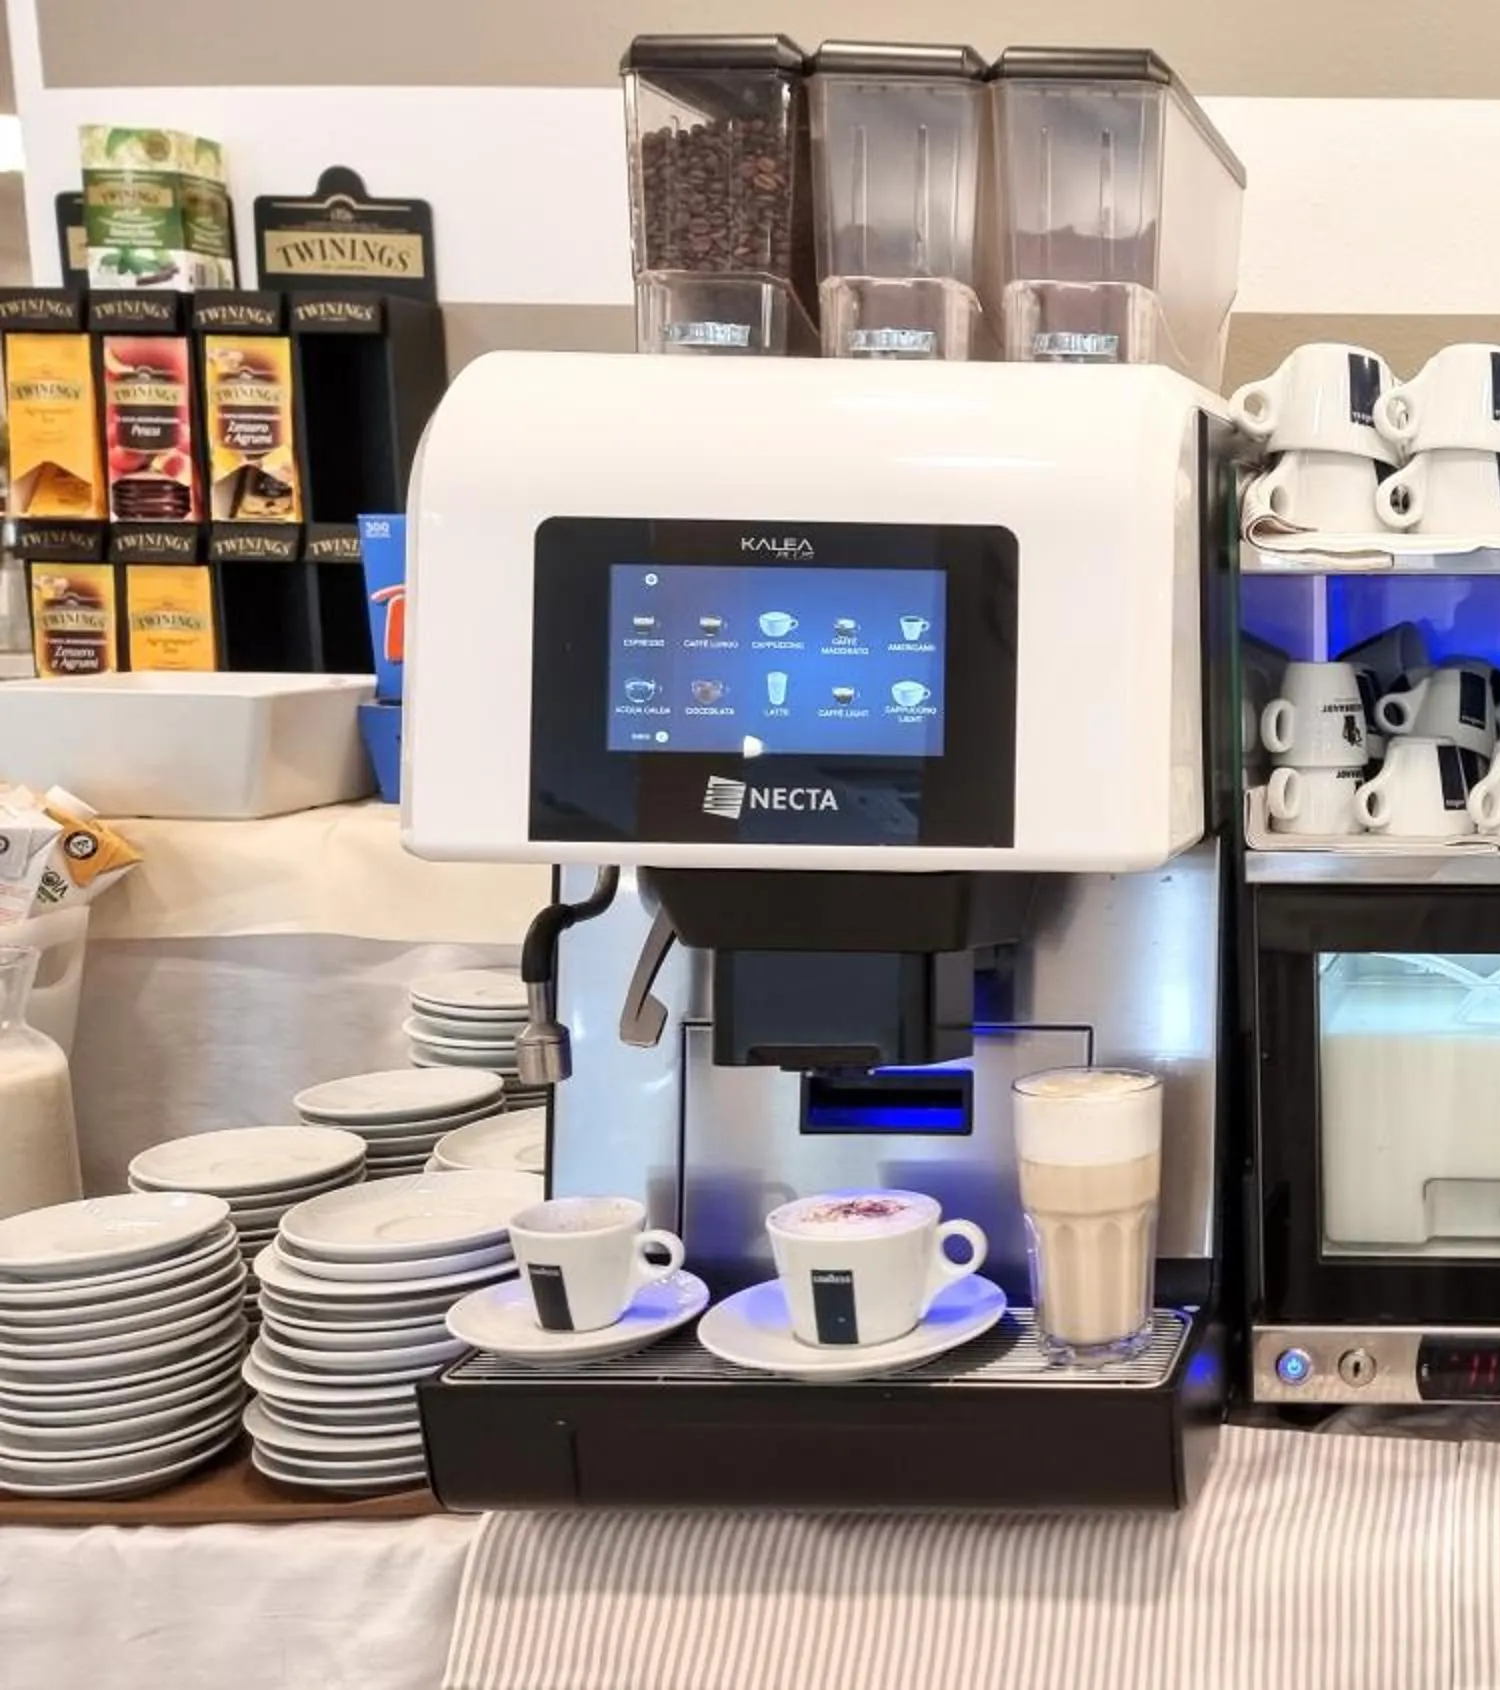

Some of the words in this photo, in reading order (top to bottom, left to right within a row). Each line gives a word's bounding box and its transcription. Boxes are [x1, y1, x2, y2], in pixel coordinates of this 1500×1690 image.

[276, 237, 411, 272] TWININGS
[95, 300, 170, 319] TWININGS
[197, 304, 275, 325] TWININGS
[297, 301, 374, 321] TWININGS
[21, 530, 95, 549] TWININGS
[116, 533, 191, 551] TWININGS
[215, 536, 294, 555] TWININGS
[311, 538, 360, 555] TWINI
[741, 537, 813, 551] KALEA
[750, 788, 839, 811] NECTA
